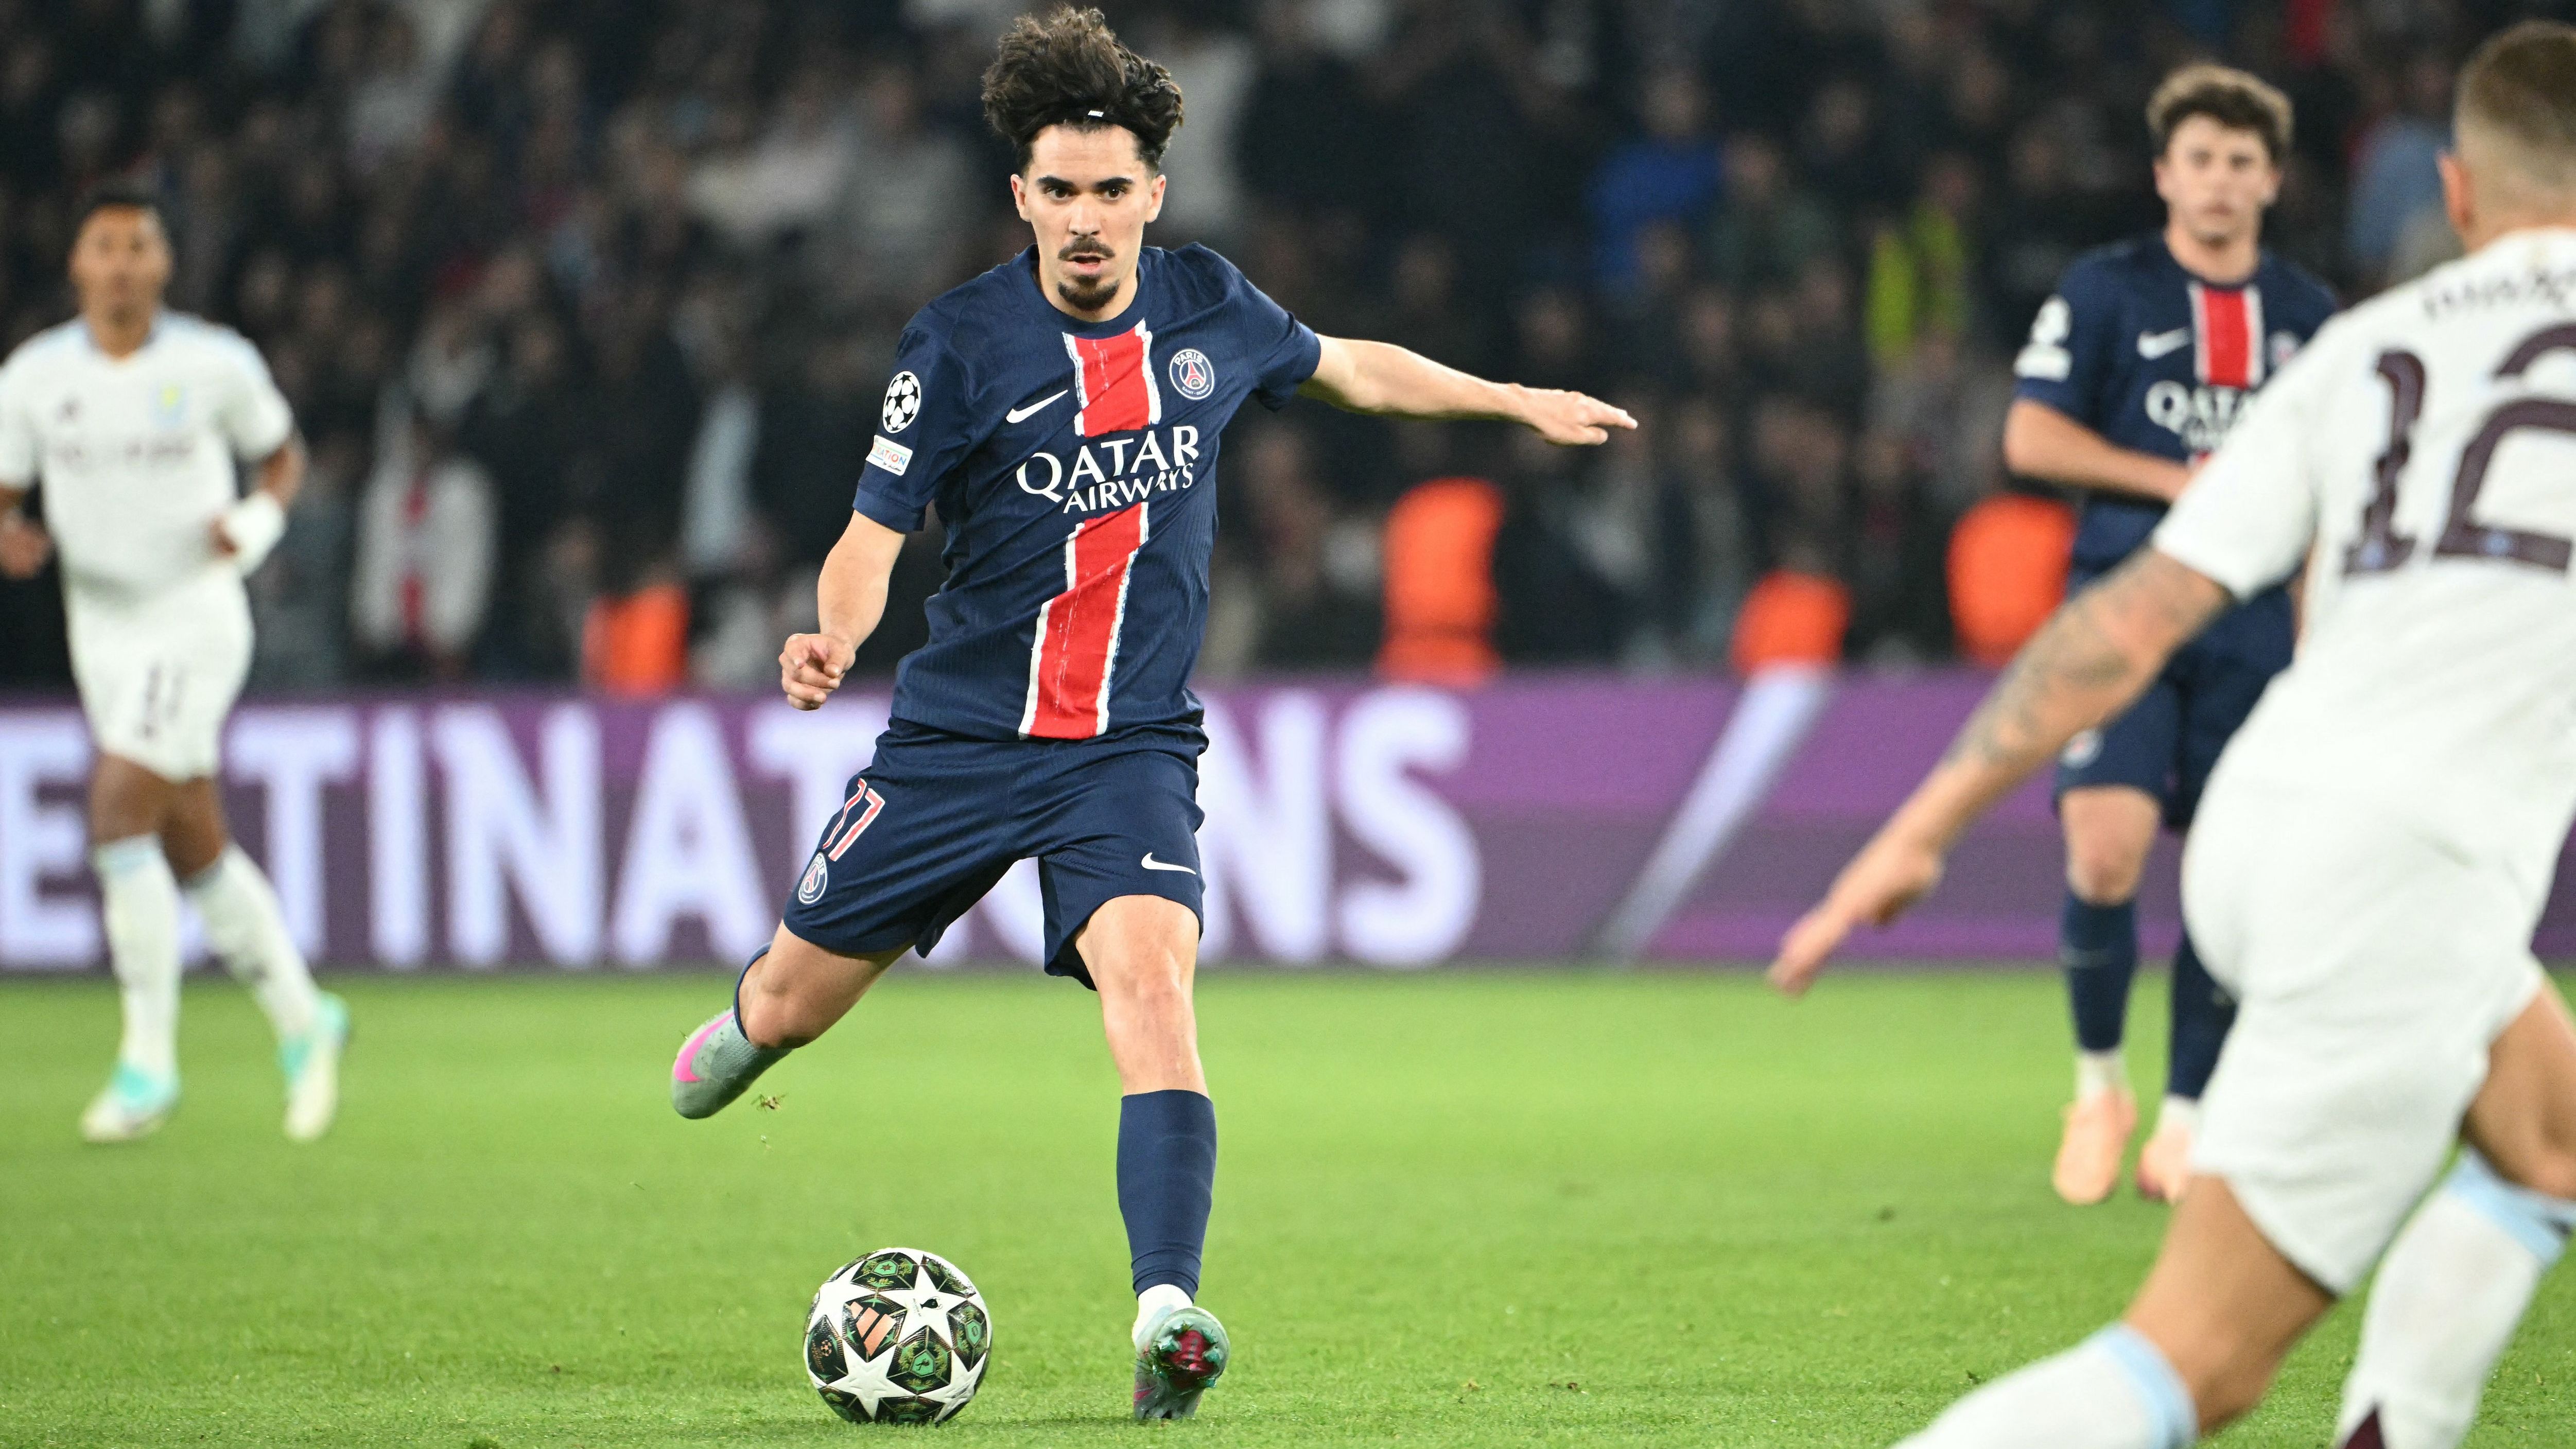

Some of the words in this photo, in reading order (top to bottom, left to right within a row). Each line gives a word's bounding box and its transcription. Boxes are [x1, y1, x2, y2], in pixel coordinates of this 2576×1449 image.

[1174, 352, 1203, 365] PARIS
[1016, 426, 1199, 503] QATAR
[1063, 463, 1193, 513] AIRWAYS
[2342, 320, 2576, 579] 12
[0, 690, 1484, 969] ETINATNS
